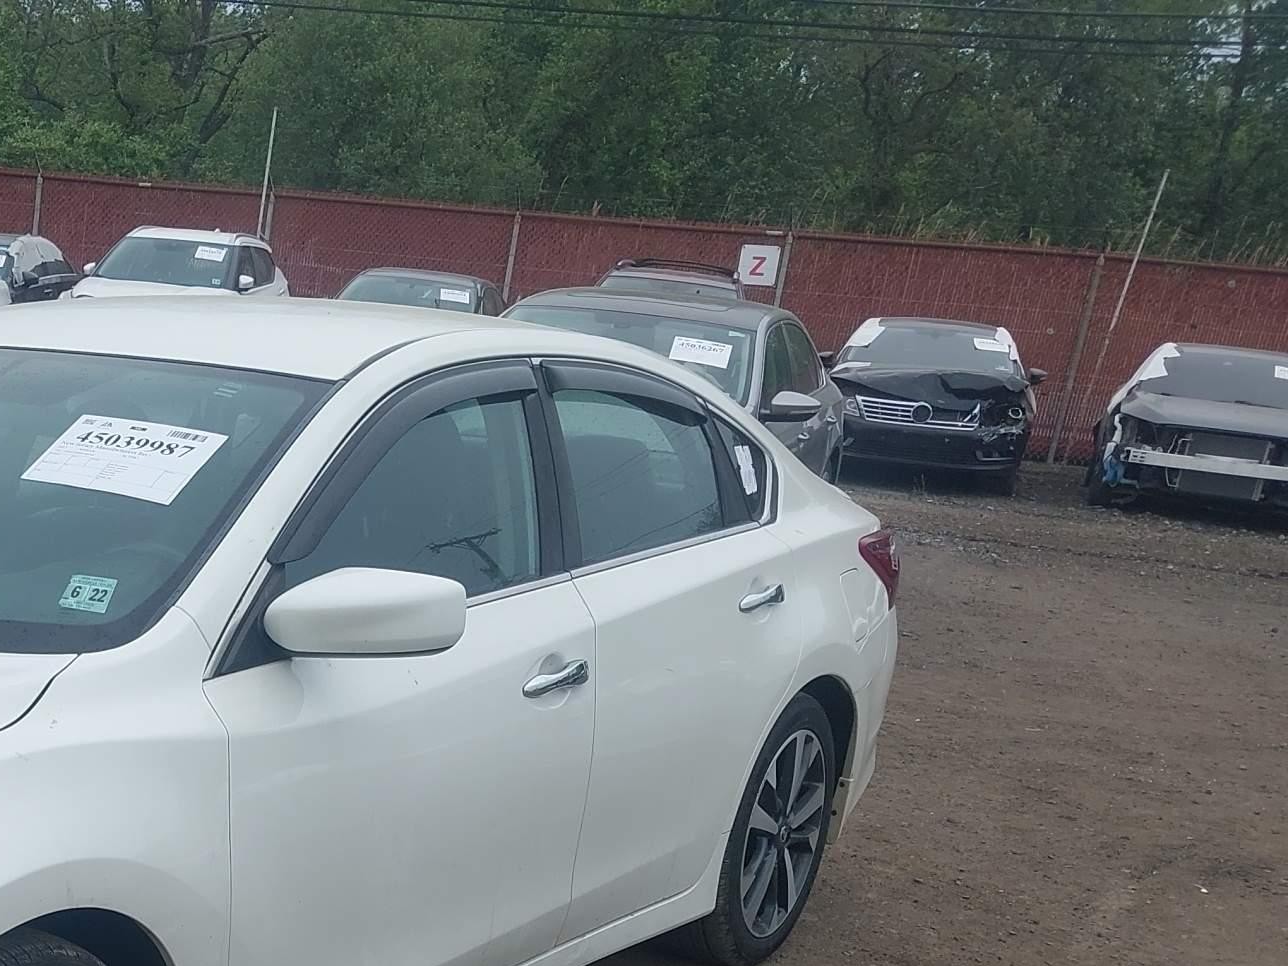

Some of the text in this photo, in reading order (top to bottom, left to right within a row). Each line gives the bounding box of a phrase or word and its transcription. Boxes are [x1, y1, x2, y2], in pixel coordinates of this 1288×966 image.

[749, 256, 767, 276] Z
[76, 430, 196, 458] 45039987
[71, 586, 108, 603] 6 22
